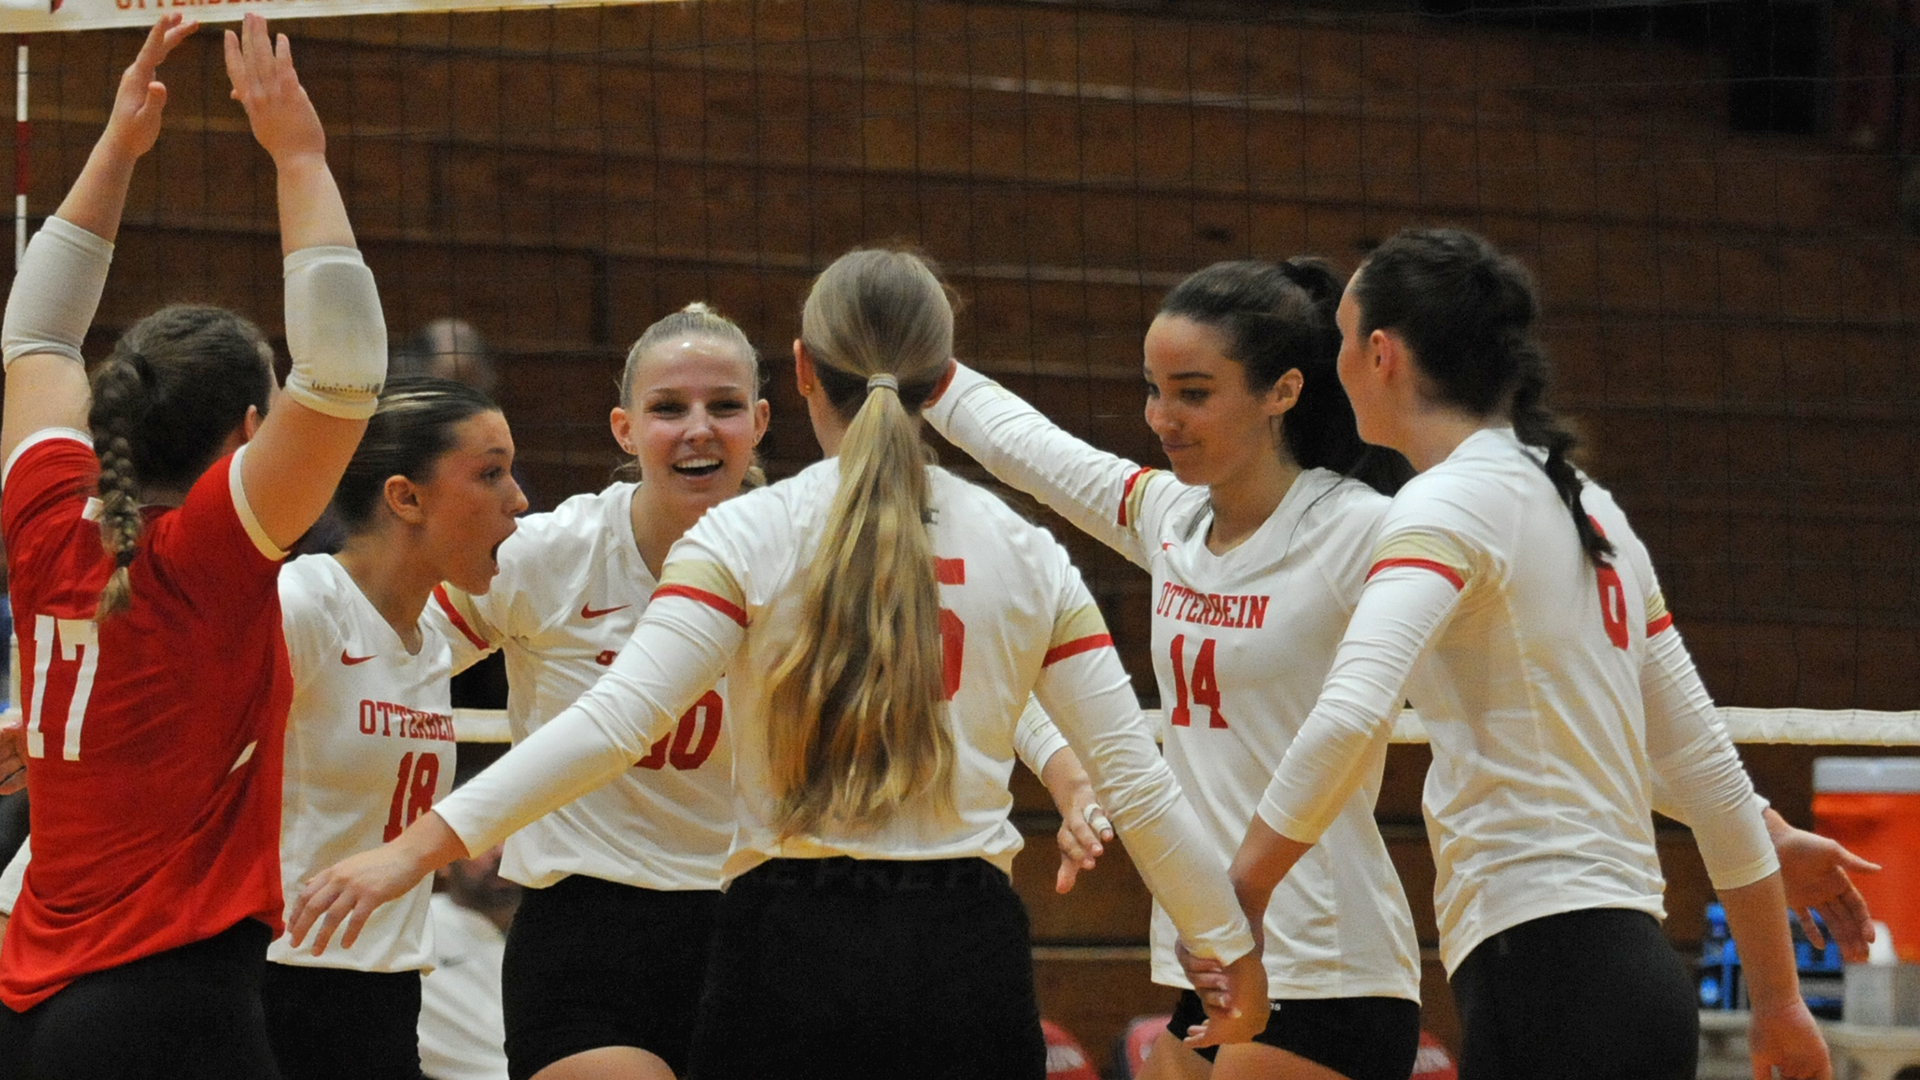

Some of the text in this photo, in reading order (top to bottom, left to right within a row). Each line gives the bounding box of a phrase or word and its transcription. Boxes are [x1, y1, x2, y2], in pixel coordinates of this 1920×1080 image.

[1156, 581, 1270, 629] OTTERBEIN
[27, 614, 99, 761] 17
[1169, 633, 1229, 729] 14
[633, 689, 724, 771] 0
[382, 751, 440, 843] 18
